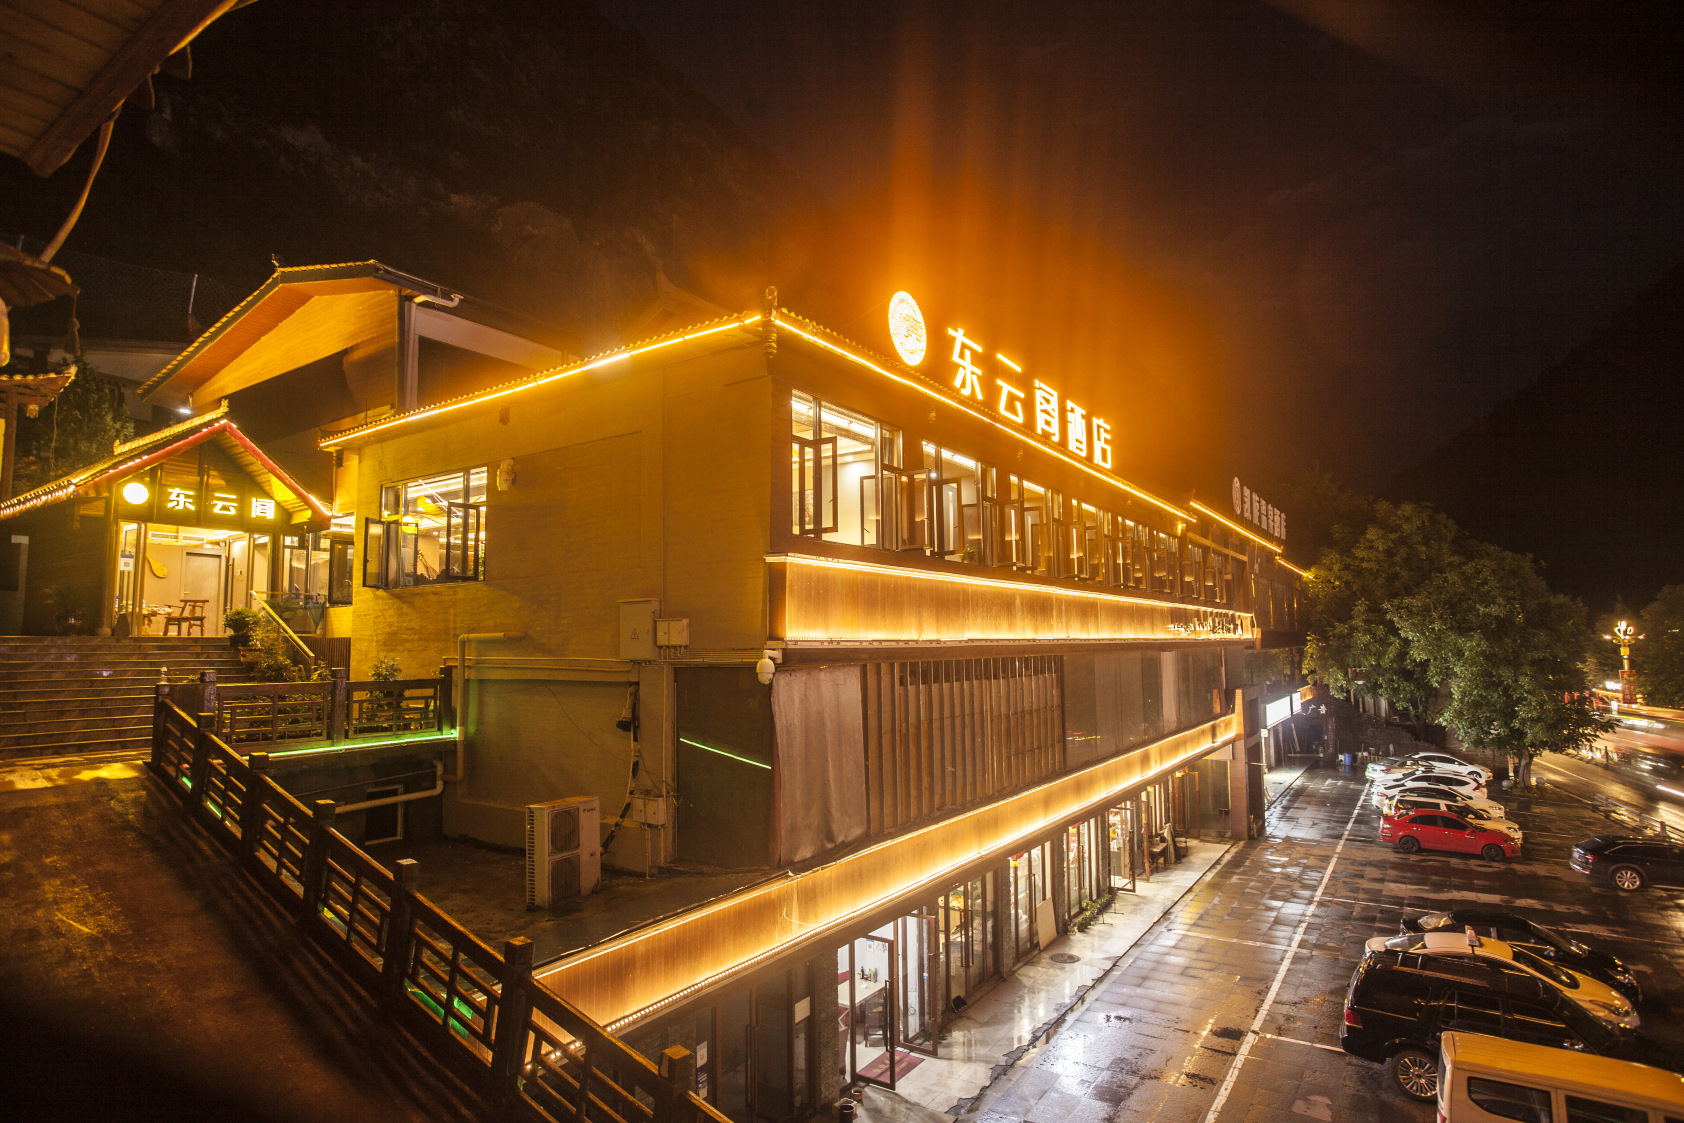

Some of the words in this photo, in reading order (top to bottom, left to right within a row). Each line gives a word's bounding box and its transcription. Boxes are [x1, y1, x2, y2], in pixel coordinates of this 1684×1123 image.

[948, 327, 1112, 468] 东云阁酒店
[167, 488, 276, 519] 东云阁
